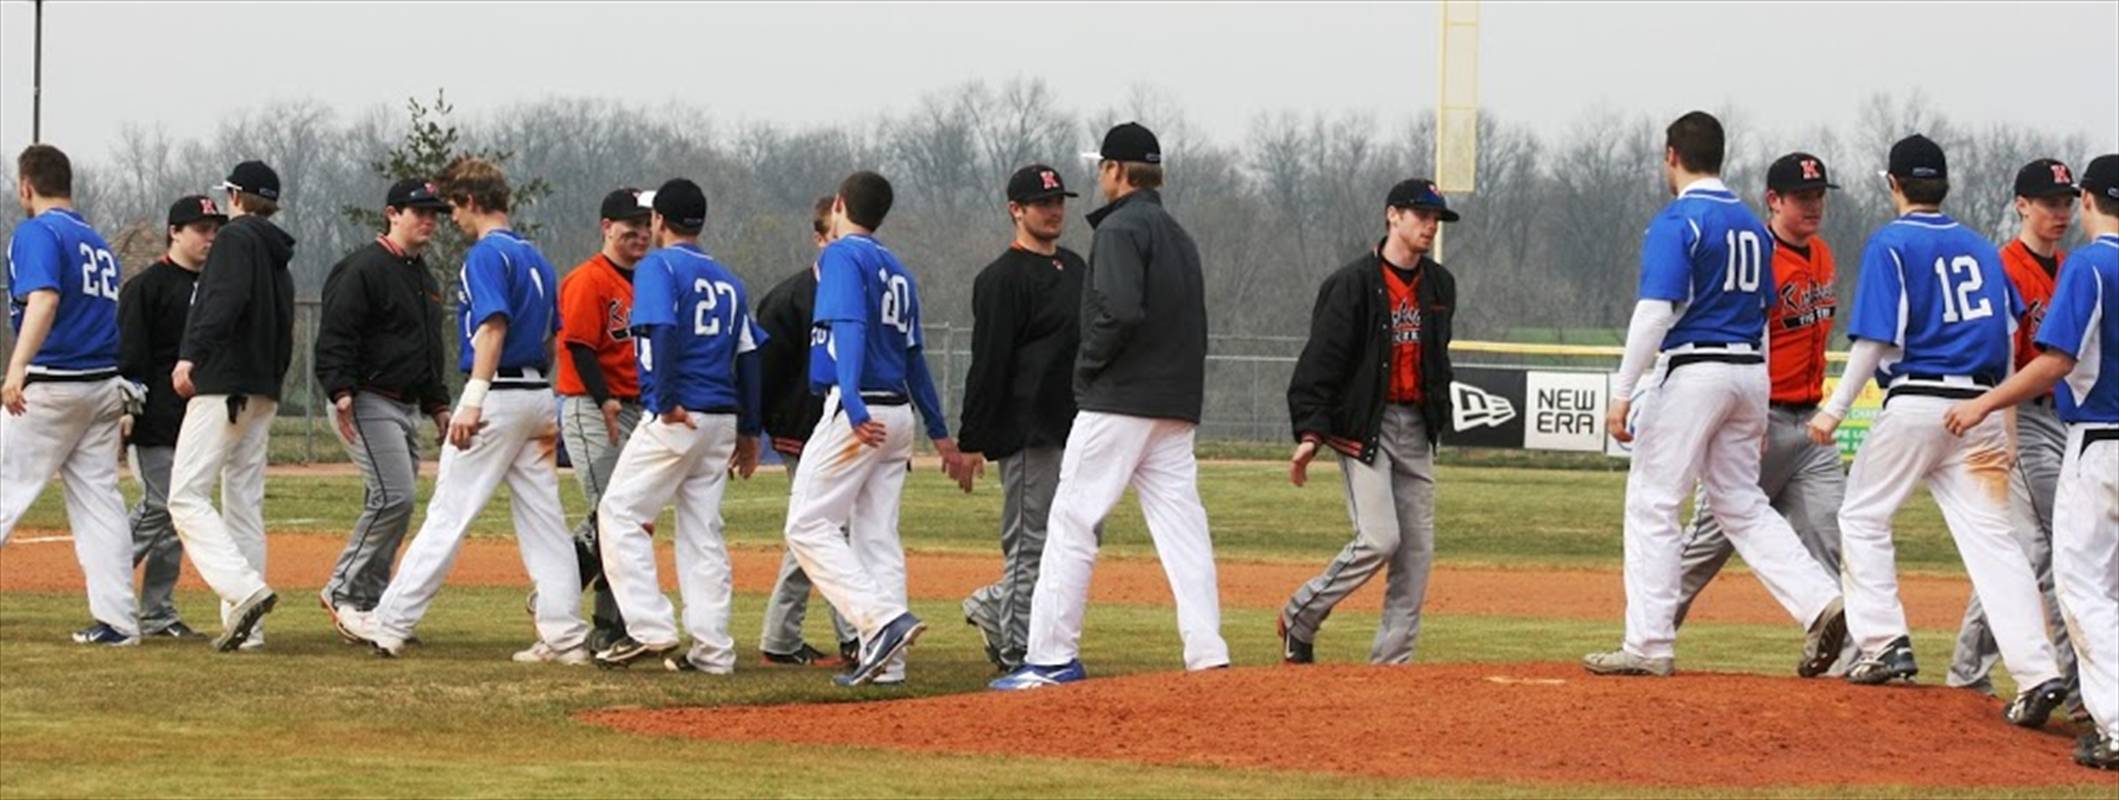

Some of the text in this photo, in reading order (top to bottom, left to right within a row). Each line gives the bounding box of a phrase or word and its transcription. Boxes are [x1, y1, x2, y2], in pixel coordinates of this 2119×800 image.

[1801, 160, 1820, 179] K
[2051, 164, 2070, 183] K
[80, 242, 119, 302] 22
[1723, 229, 1761, 292] 10
[694, 278, 737, 335] 27
[1934, 256, 1993, 322] 12
[1538, 388, 1595, 411] NEW
[1537, 411, 1594, 434] ERA
